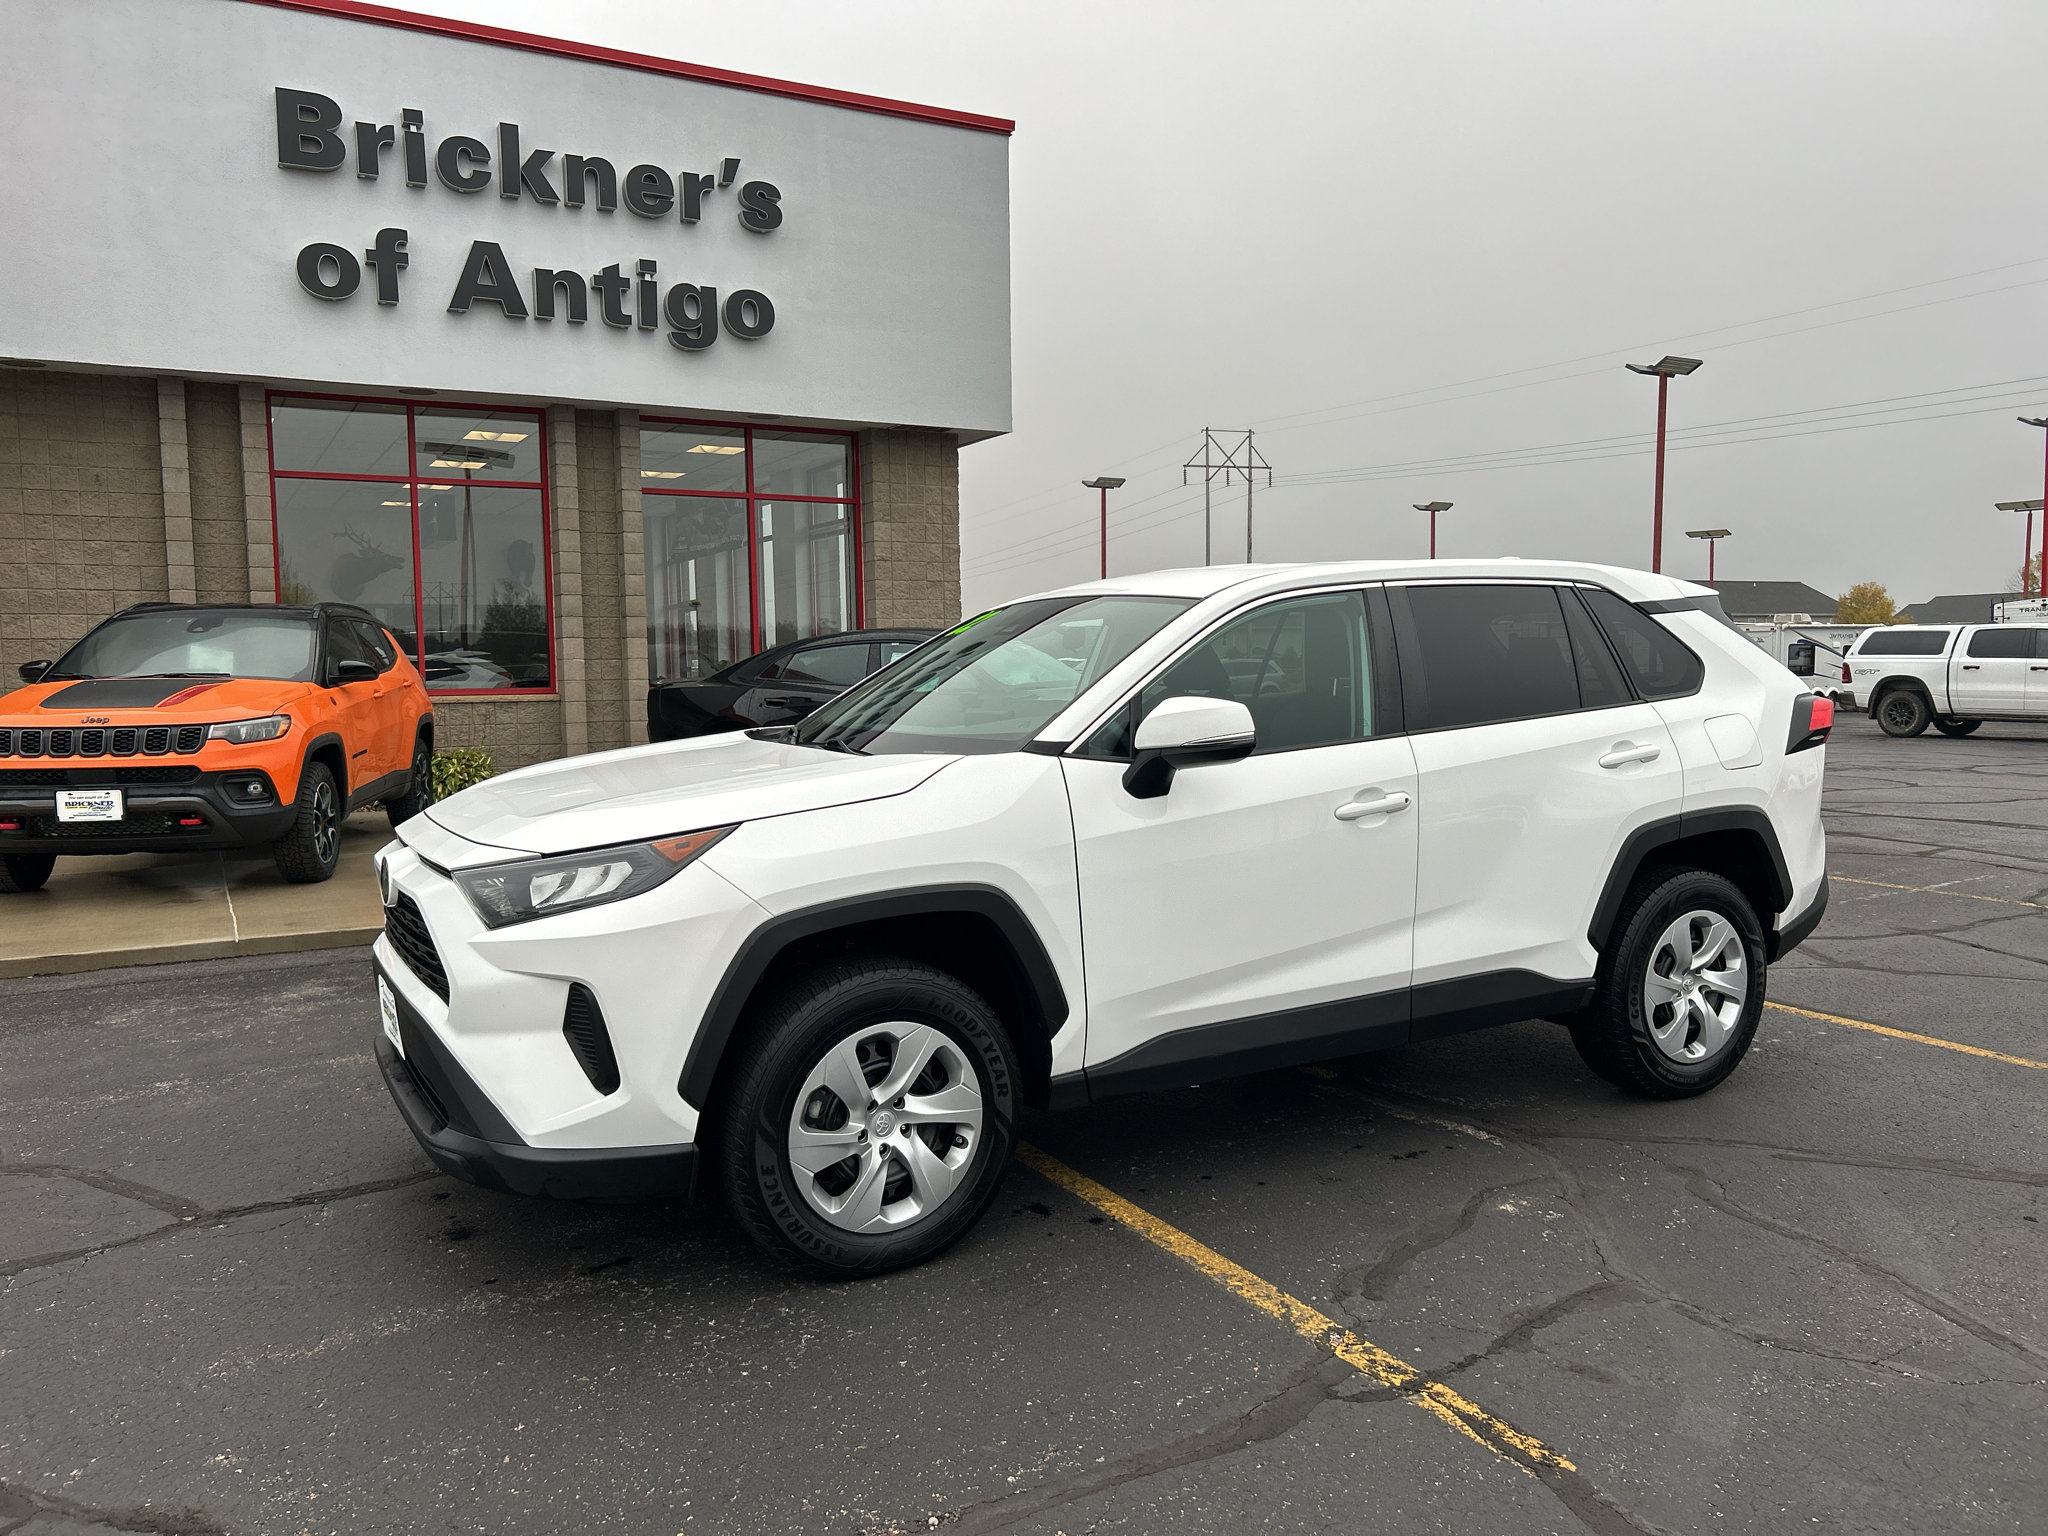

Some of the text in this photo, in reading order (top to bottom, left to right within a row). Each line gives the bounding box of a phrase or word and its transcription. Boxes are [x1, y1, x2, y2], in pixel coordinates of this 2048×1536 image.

[274, 86, 783, 234] Brickner's
[295, 227, 776, 351] of Antigo
[81, 716, 110, 725] Jeep
[928, 996, 1009, 1098] GOODYEAR
[760, 1164, 851, 1260] ASSURANCE
